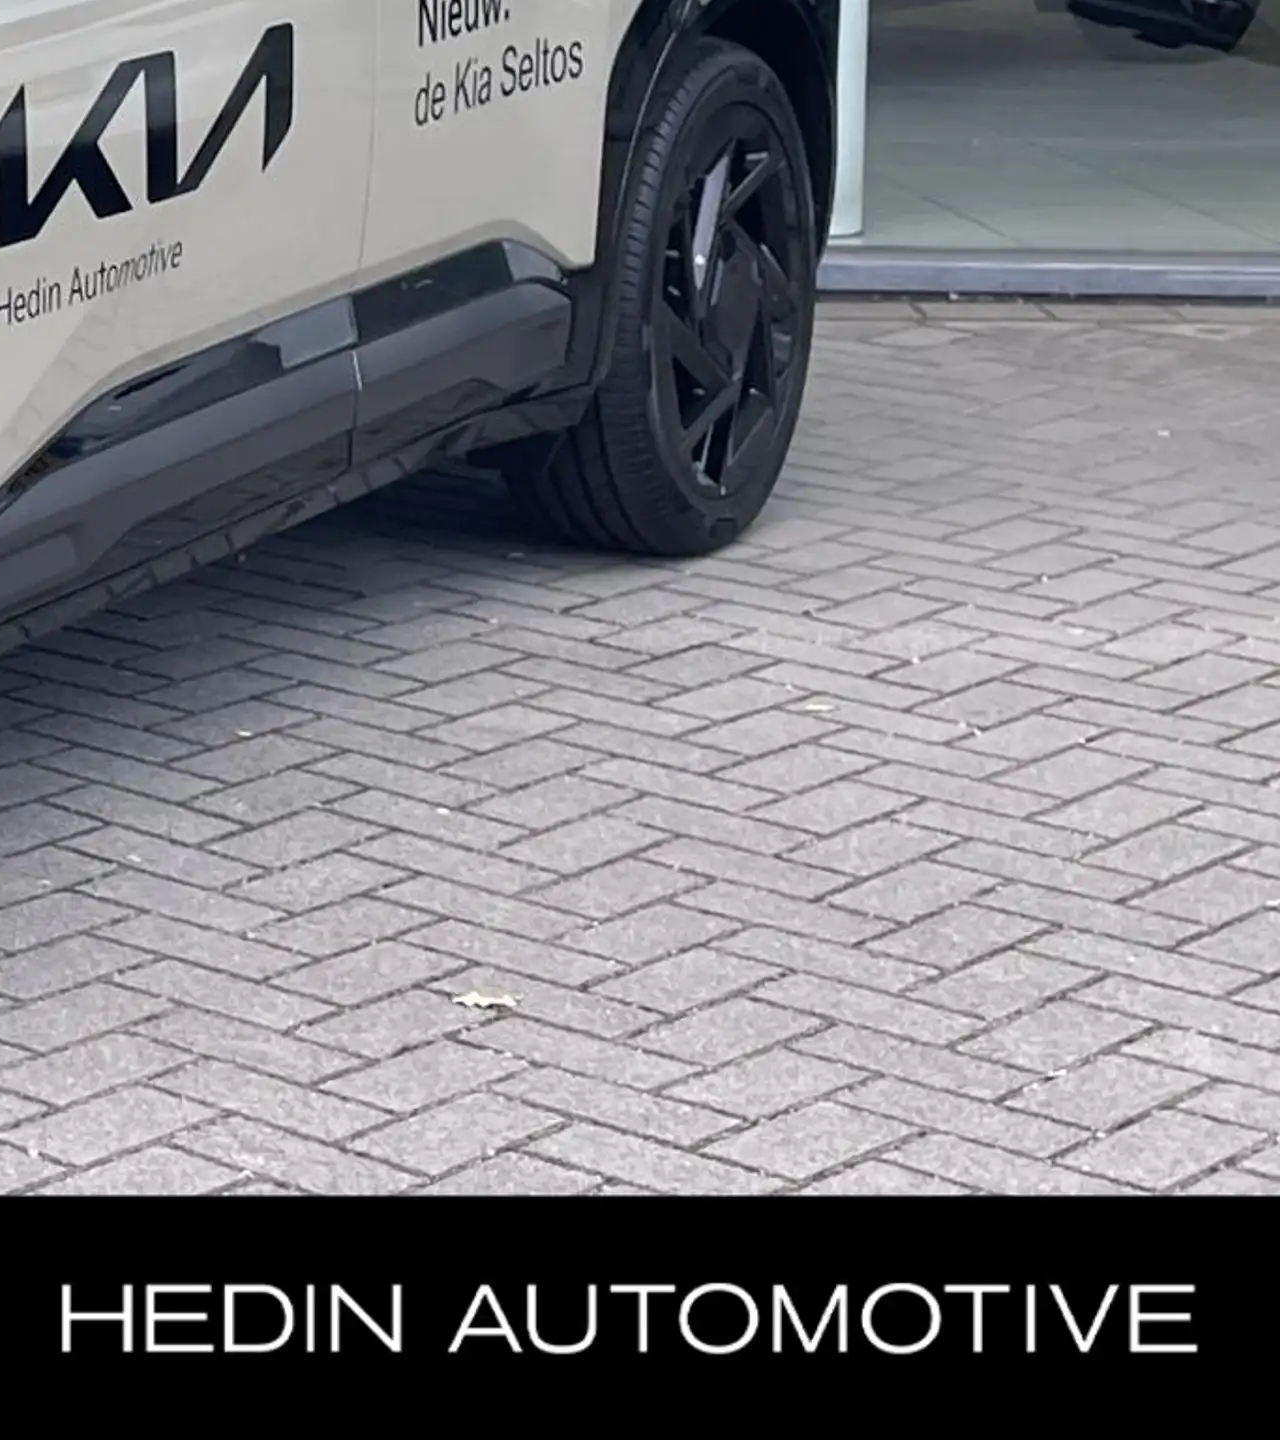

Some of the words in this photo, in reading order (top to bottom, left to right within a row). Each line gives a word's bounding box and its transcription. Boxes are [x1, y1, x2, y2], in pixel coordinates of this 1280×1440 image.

[415, 72, 446, 126] de
[454, 57, 492, 114] Kia
[500, 37, 583, 97] Seltos
[68, 239, 183, 305] Automotive
